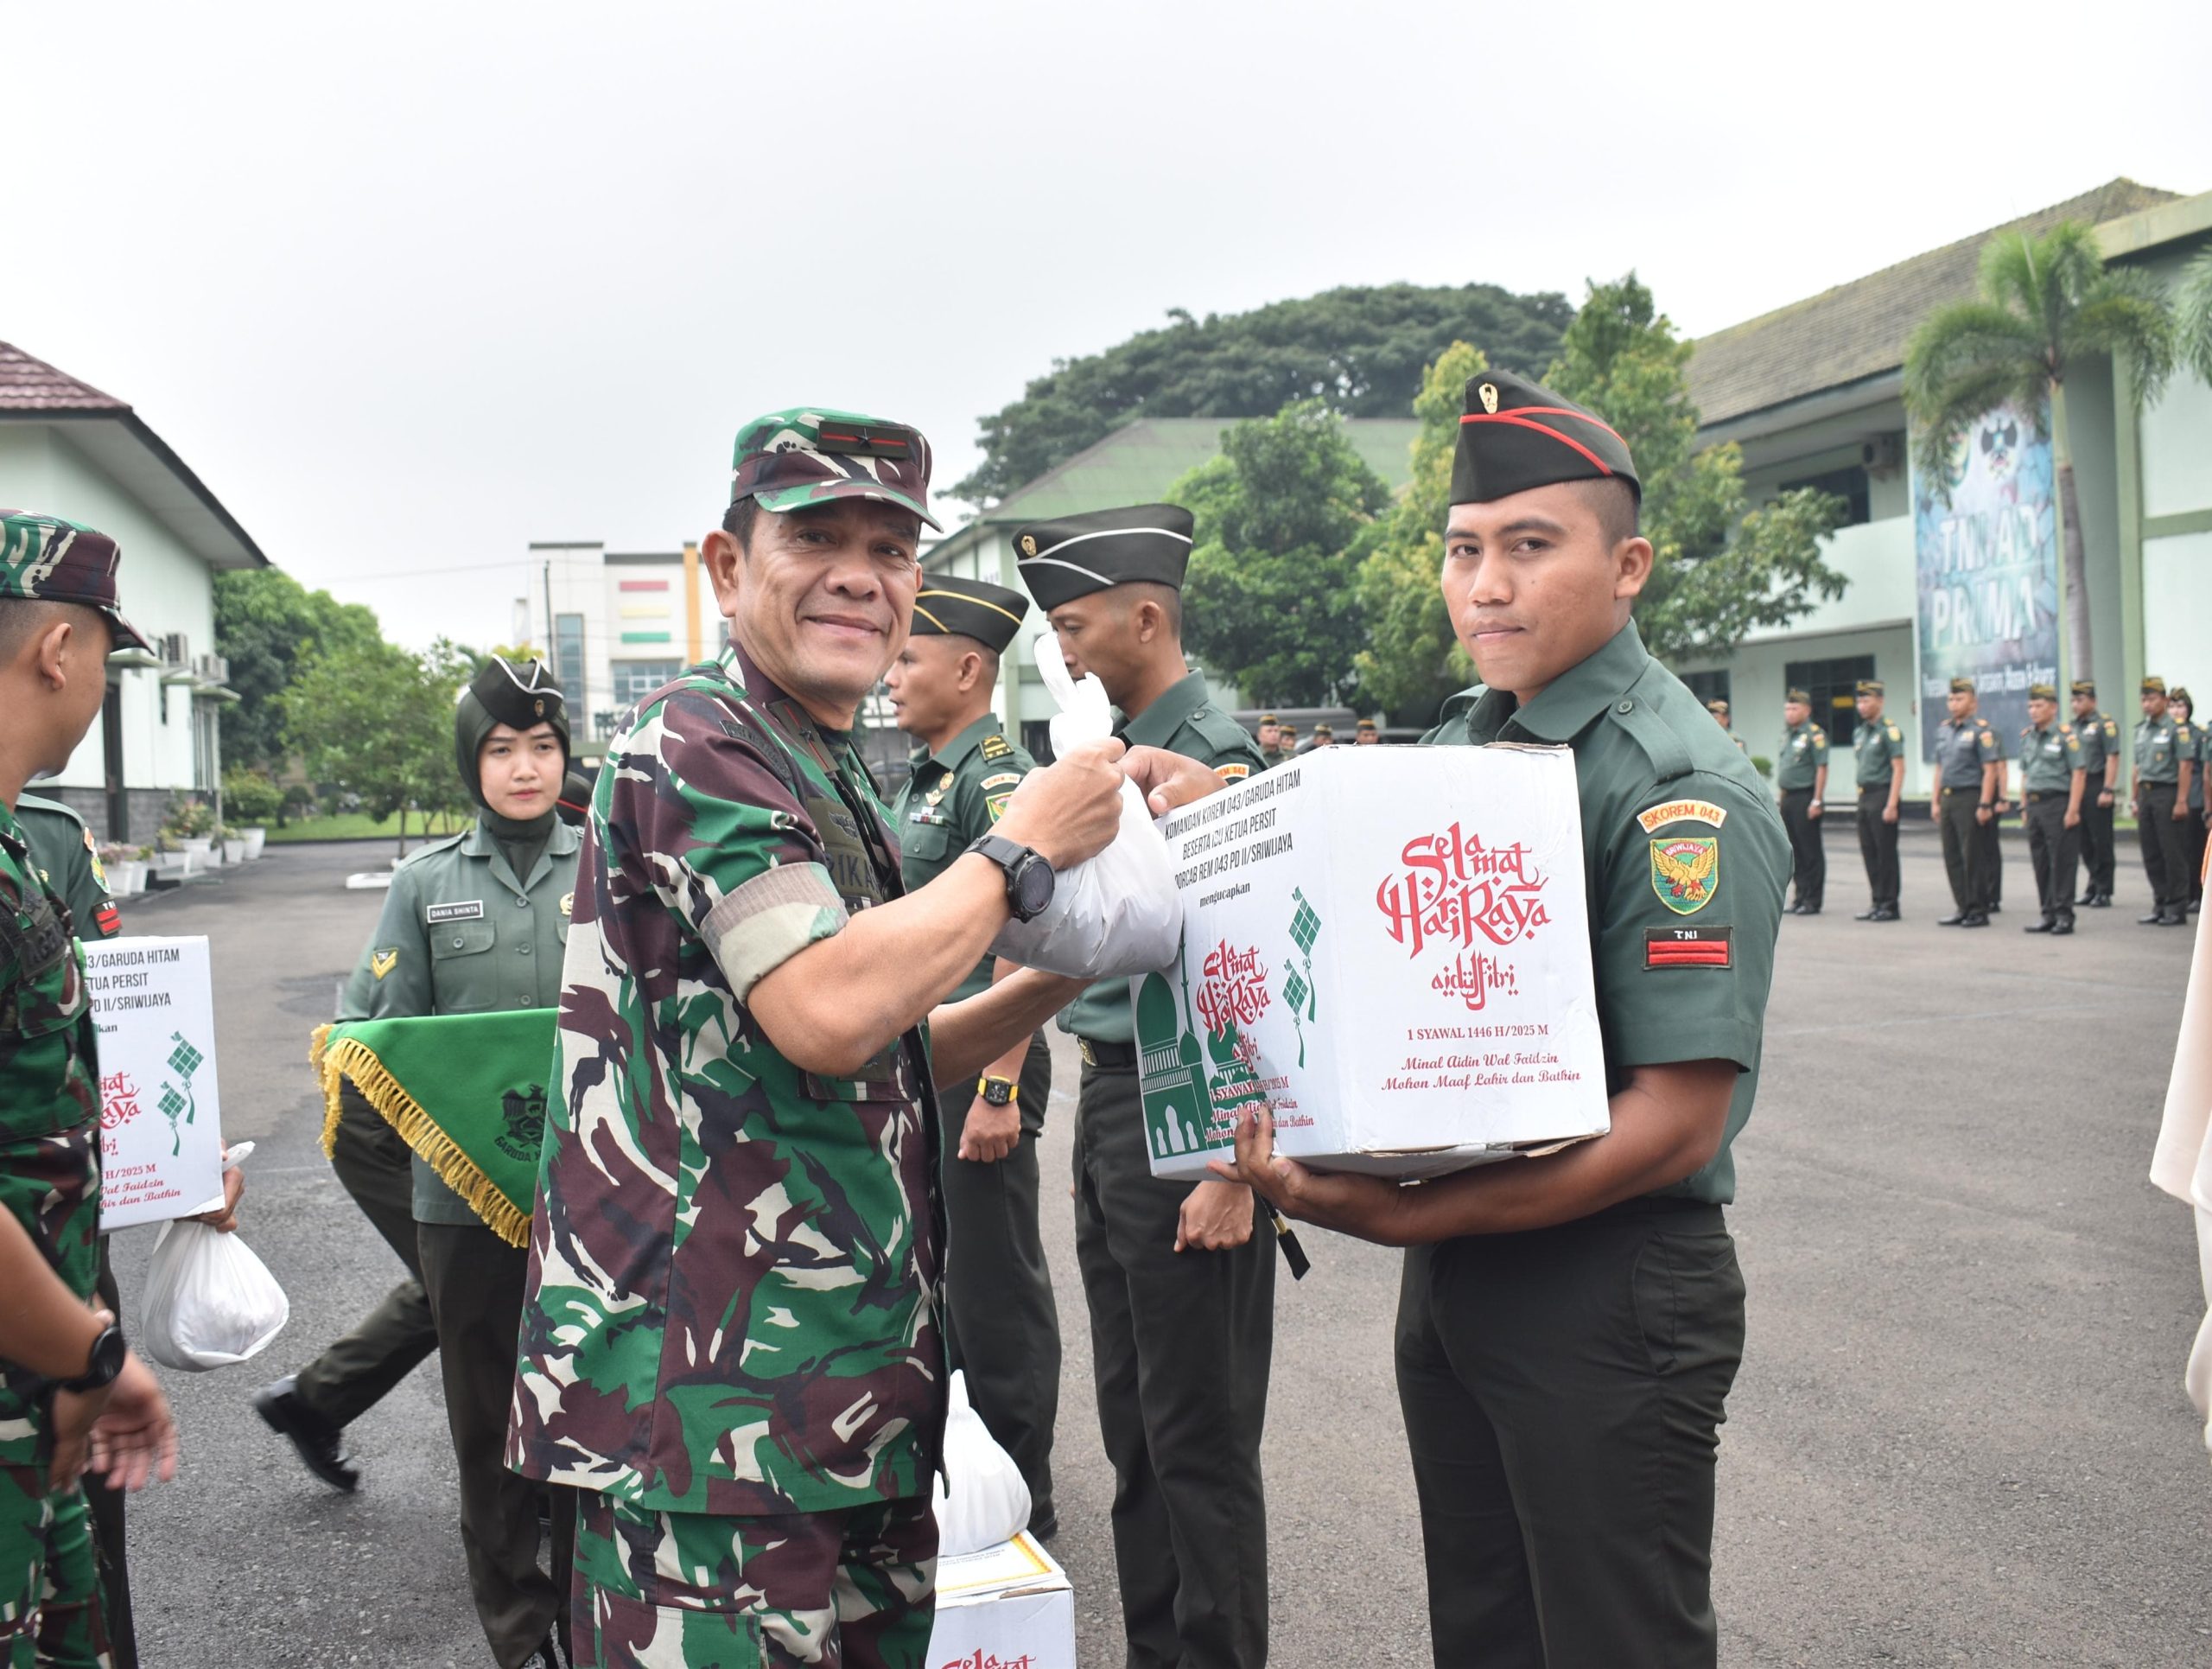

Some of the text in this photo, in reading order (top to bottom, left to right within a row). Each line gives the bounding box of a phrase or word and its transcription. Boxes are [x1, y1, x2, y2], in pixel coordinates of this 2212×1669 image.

[1165, 768, 1300, 841] KOMANDAN KOREM 043/GARUDA HITAM
[1644, 804, 1720, 827] SKOREM 043
[1183, 834, 1211, 861] BESERTA
[1224, 818, 1248, 844] KETUA
[1249, 807, 1277, 838] PERSIT
[1199, 860, 1213, 882] REM
[1215, 853, 1228, 875] 043
[1230, 849, 1240, 870] PD
[1241, 832, 1294, 866] II/SRIWIJAYA
[1664, 842, 1704, 857] SRIWIJAYA
[1402, 821, 1541, 903] Selamat
[1199, 882, 1251, 908] mengucapkan
[431, 905, 480, 917] DANIA SHINTA
[1376, 871, 1553, 960] Hari Raya
[1674, 930, 1698, 940] TNI
[84, 948, 180, 969] 3/GARUDA HITAM
[112, 972, 149, 989] PERSIT
[104, 992, 171, 1012] II/SRIWIJAYA
[1227, 968, 1271, 1030] Raya
[1407, 1023, 1549, 1041] 1 SYAWAL 1446 H/2025 M
[1401, 1051, 1559, 1071] Minal Aidin Wal Faidzin
[1281, 1075, 1290, 1089] M
[1382, 1068, 1581, 1091] Mohon Maaf Lahir dan Bathin
[1290, 1115, 1314, 1128] Bathin
[494, 1136, 531, 1163] GARUDA
[105, 1163, 156, 1180] H/2025 M
[123, 1179, 164, 1193] Faidzin
[119, 1194, 141, 1207] dan
[144, 1188, 181, 1202] Bathin
